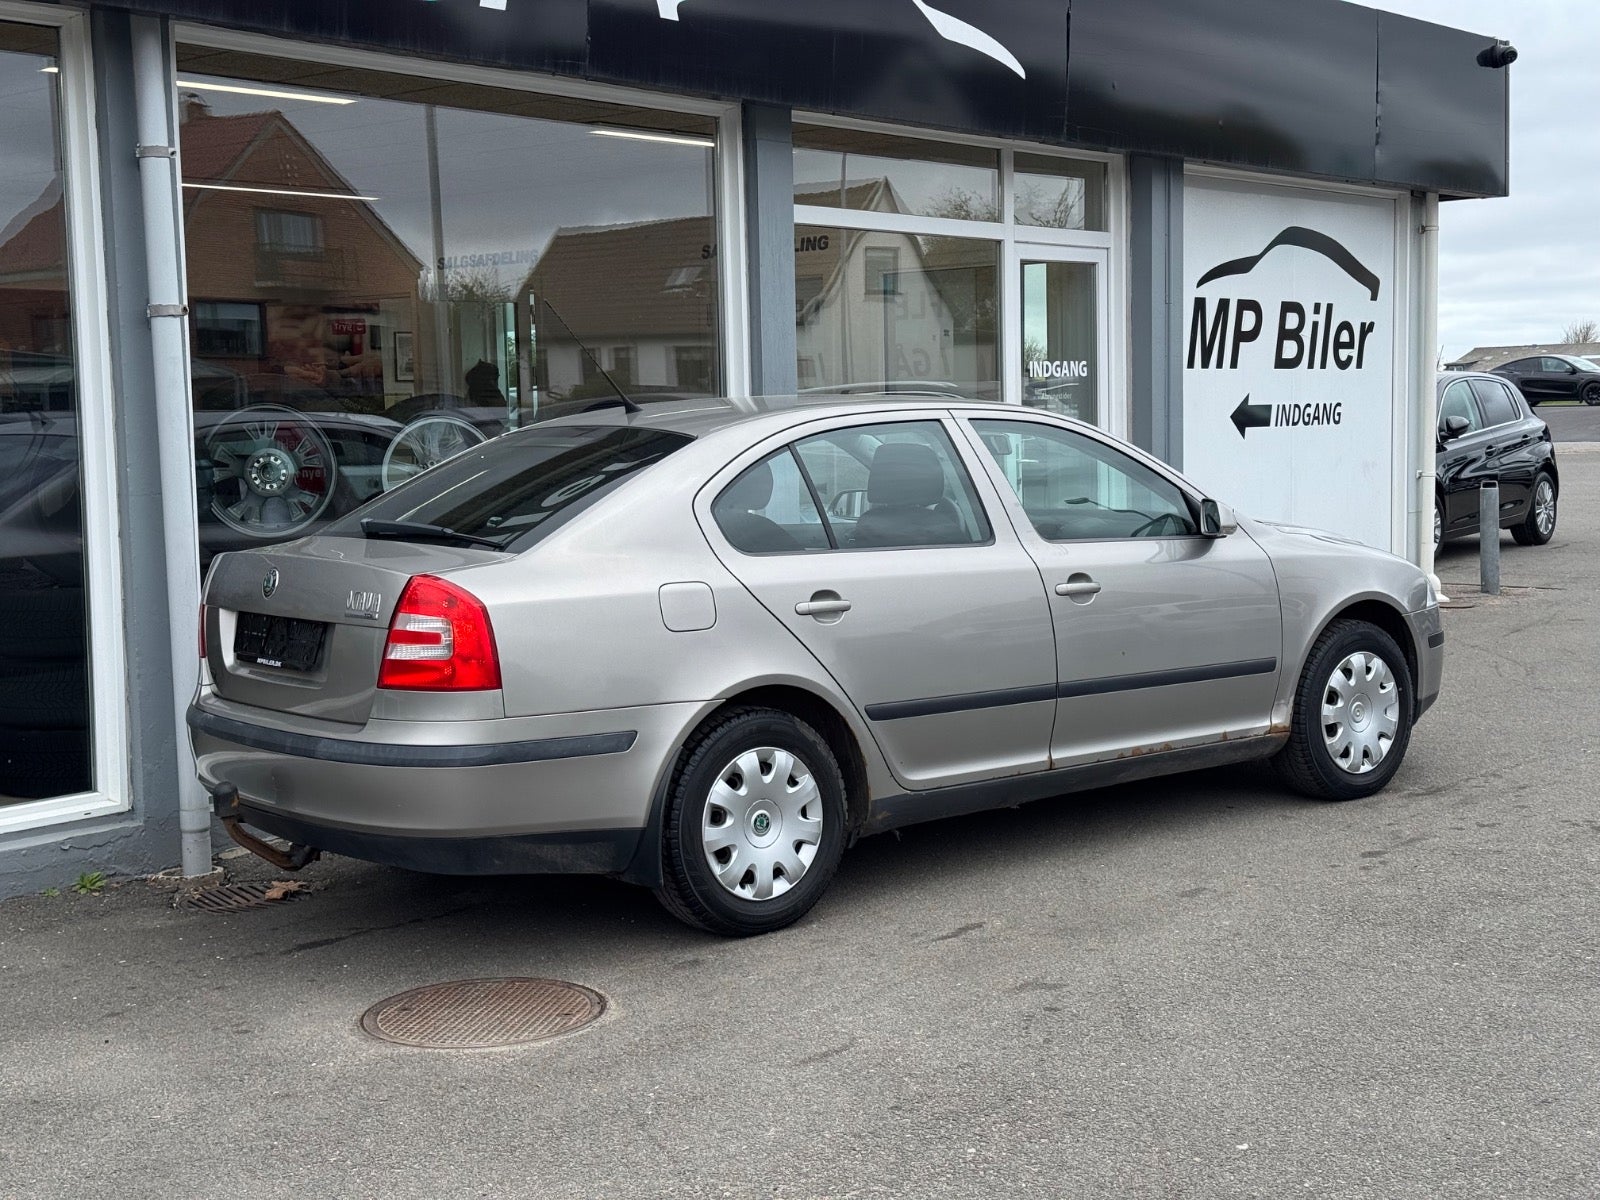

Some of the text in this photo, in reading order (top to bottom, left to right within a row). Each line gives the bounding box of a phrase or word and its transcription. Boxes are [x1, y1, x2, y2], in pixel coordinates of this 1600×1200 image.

[1187, 297, 1375, 370] MP Biler
[1030, 361, 1088, 378] INDGANG
[1275, 402, 1342, 427] INDGANG
